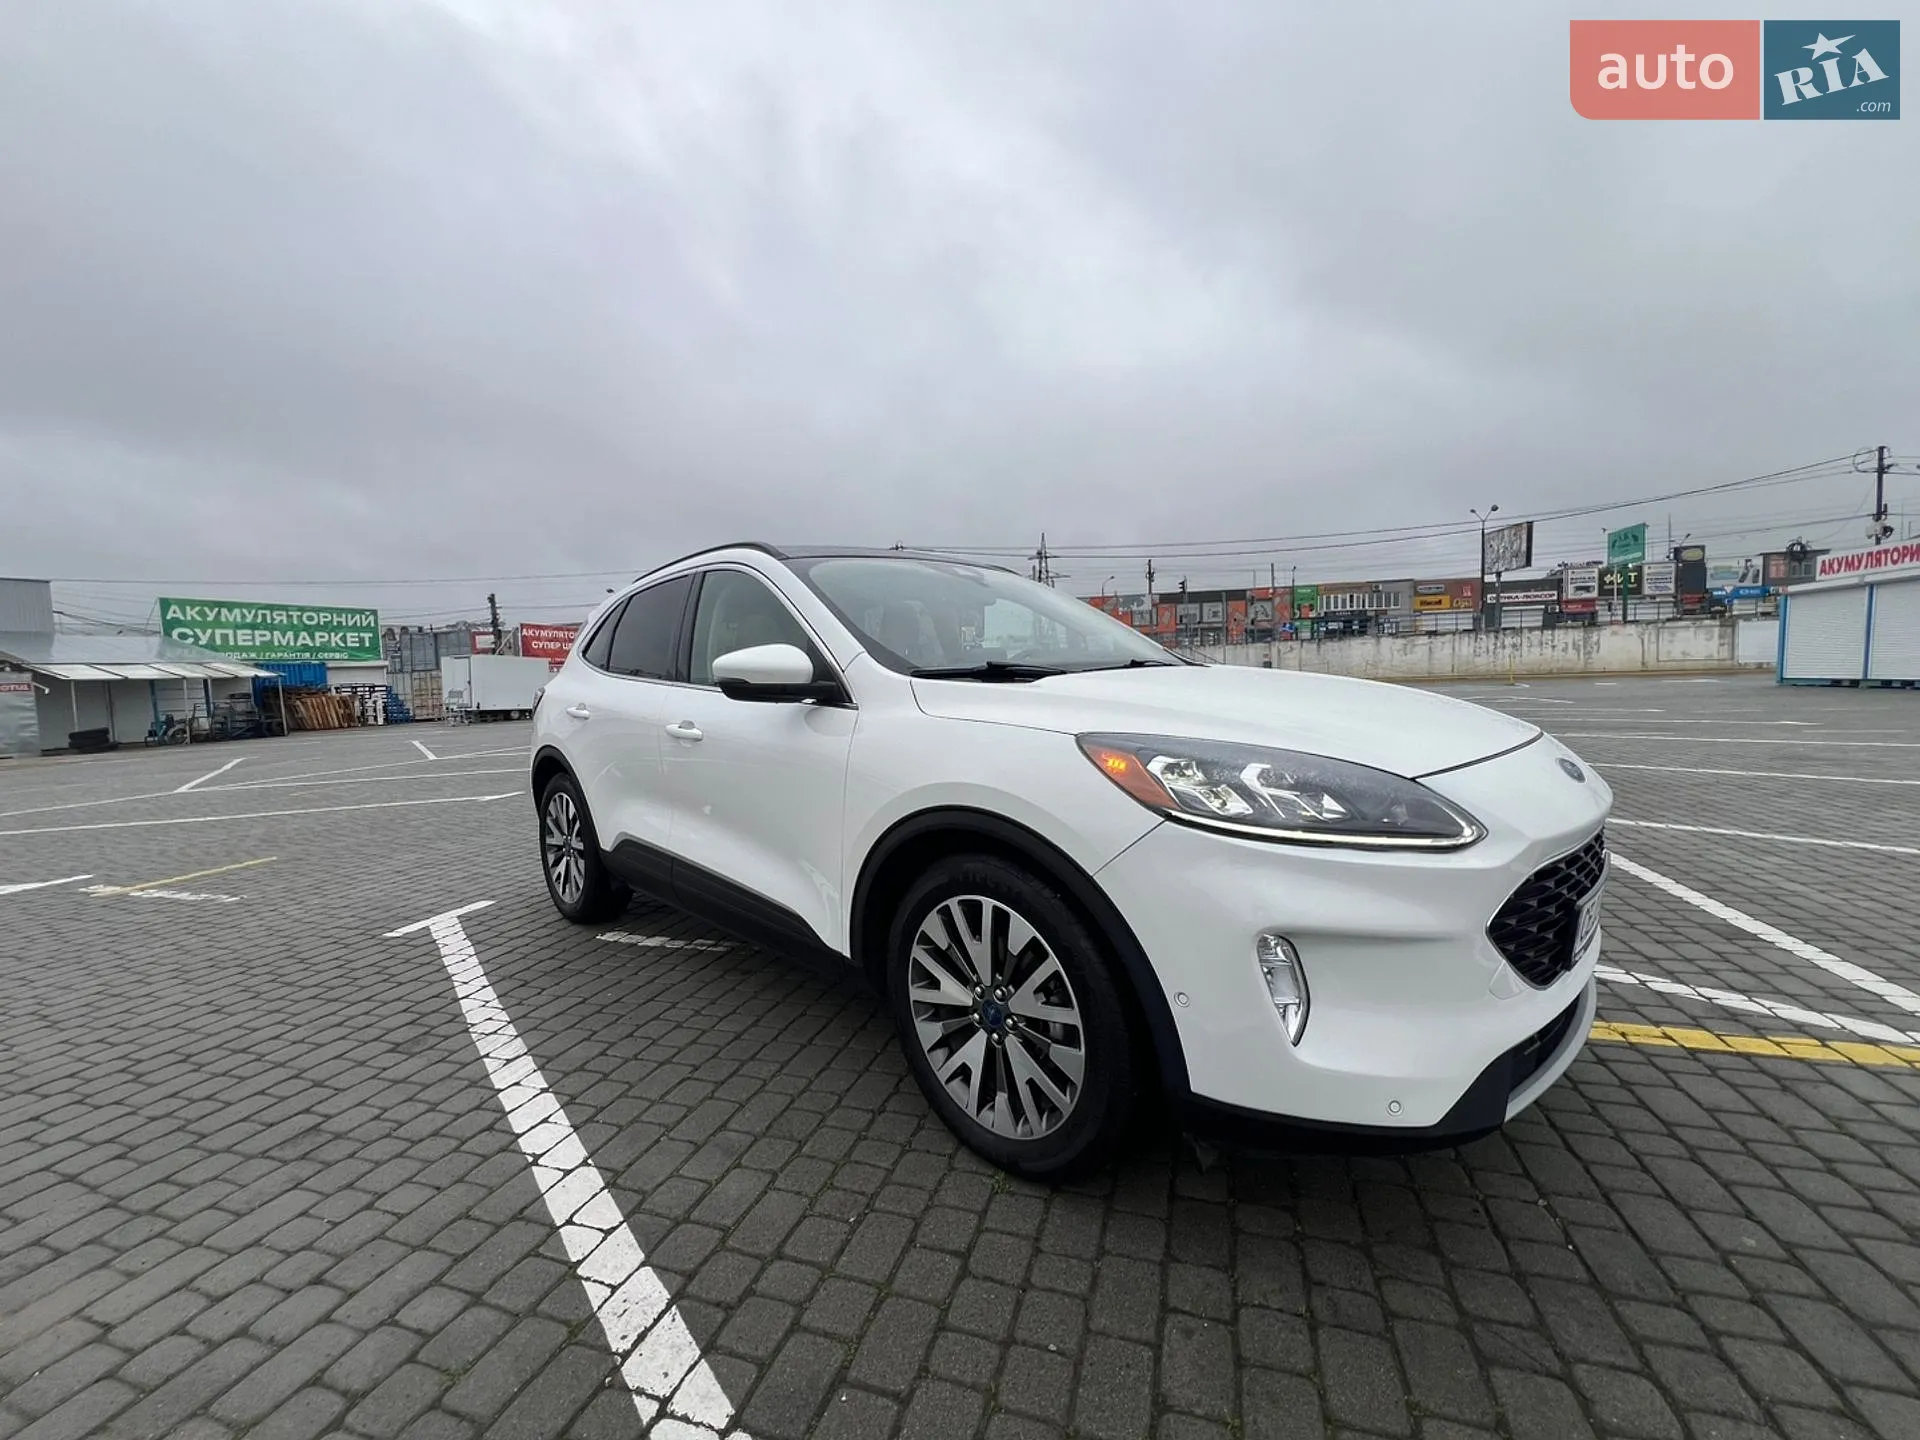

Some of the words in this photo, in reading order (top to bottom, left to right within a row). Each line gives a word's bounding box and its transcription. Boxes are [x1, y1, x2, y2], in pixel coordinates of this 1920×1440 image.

[166, 604, 375, 627] АКУМУЛЯТОРНИЙ
[171, 628, 373, 647] СУПЕРМАРКЕТ
[532, 641, 560, 650] СУПЕР
